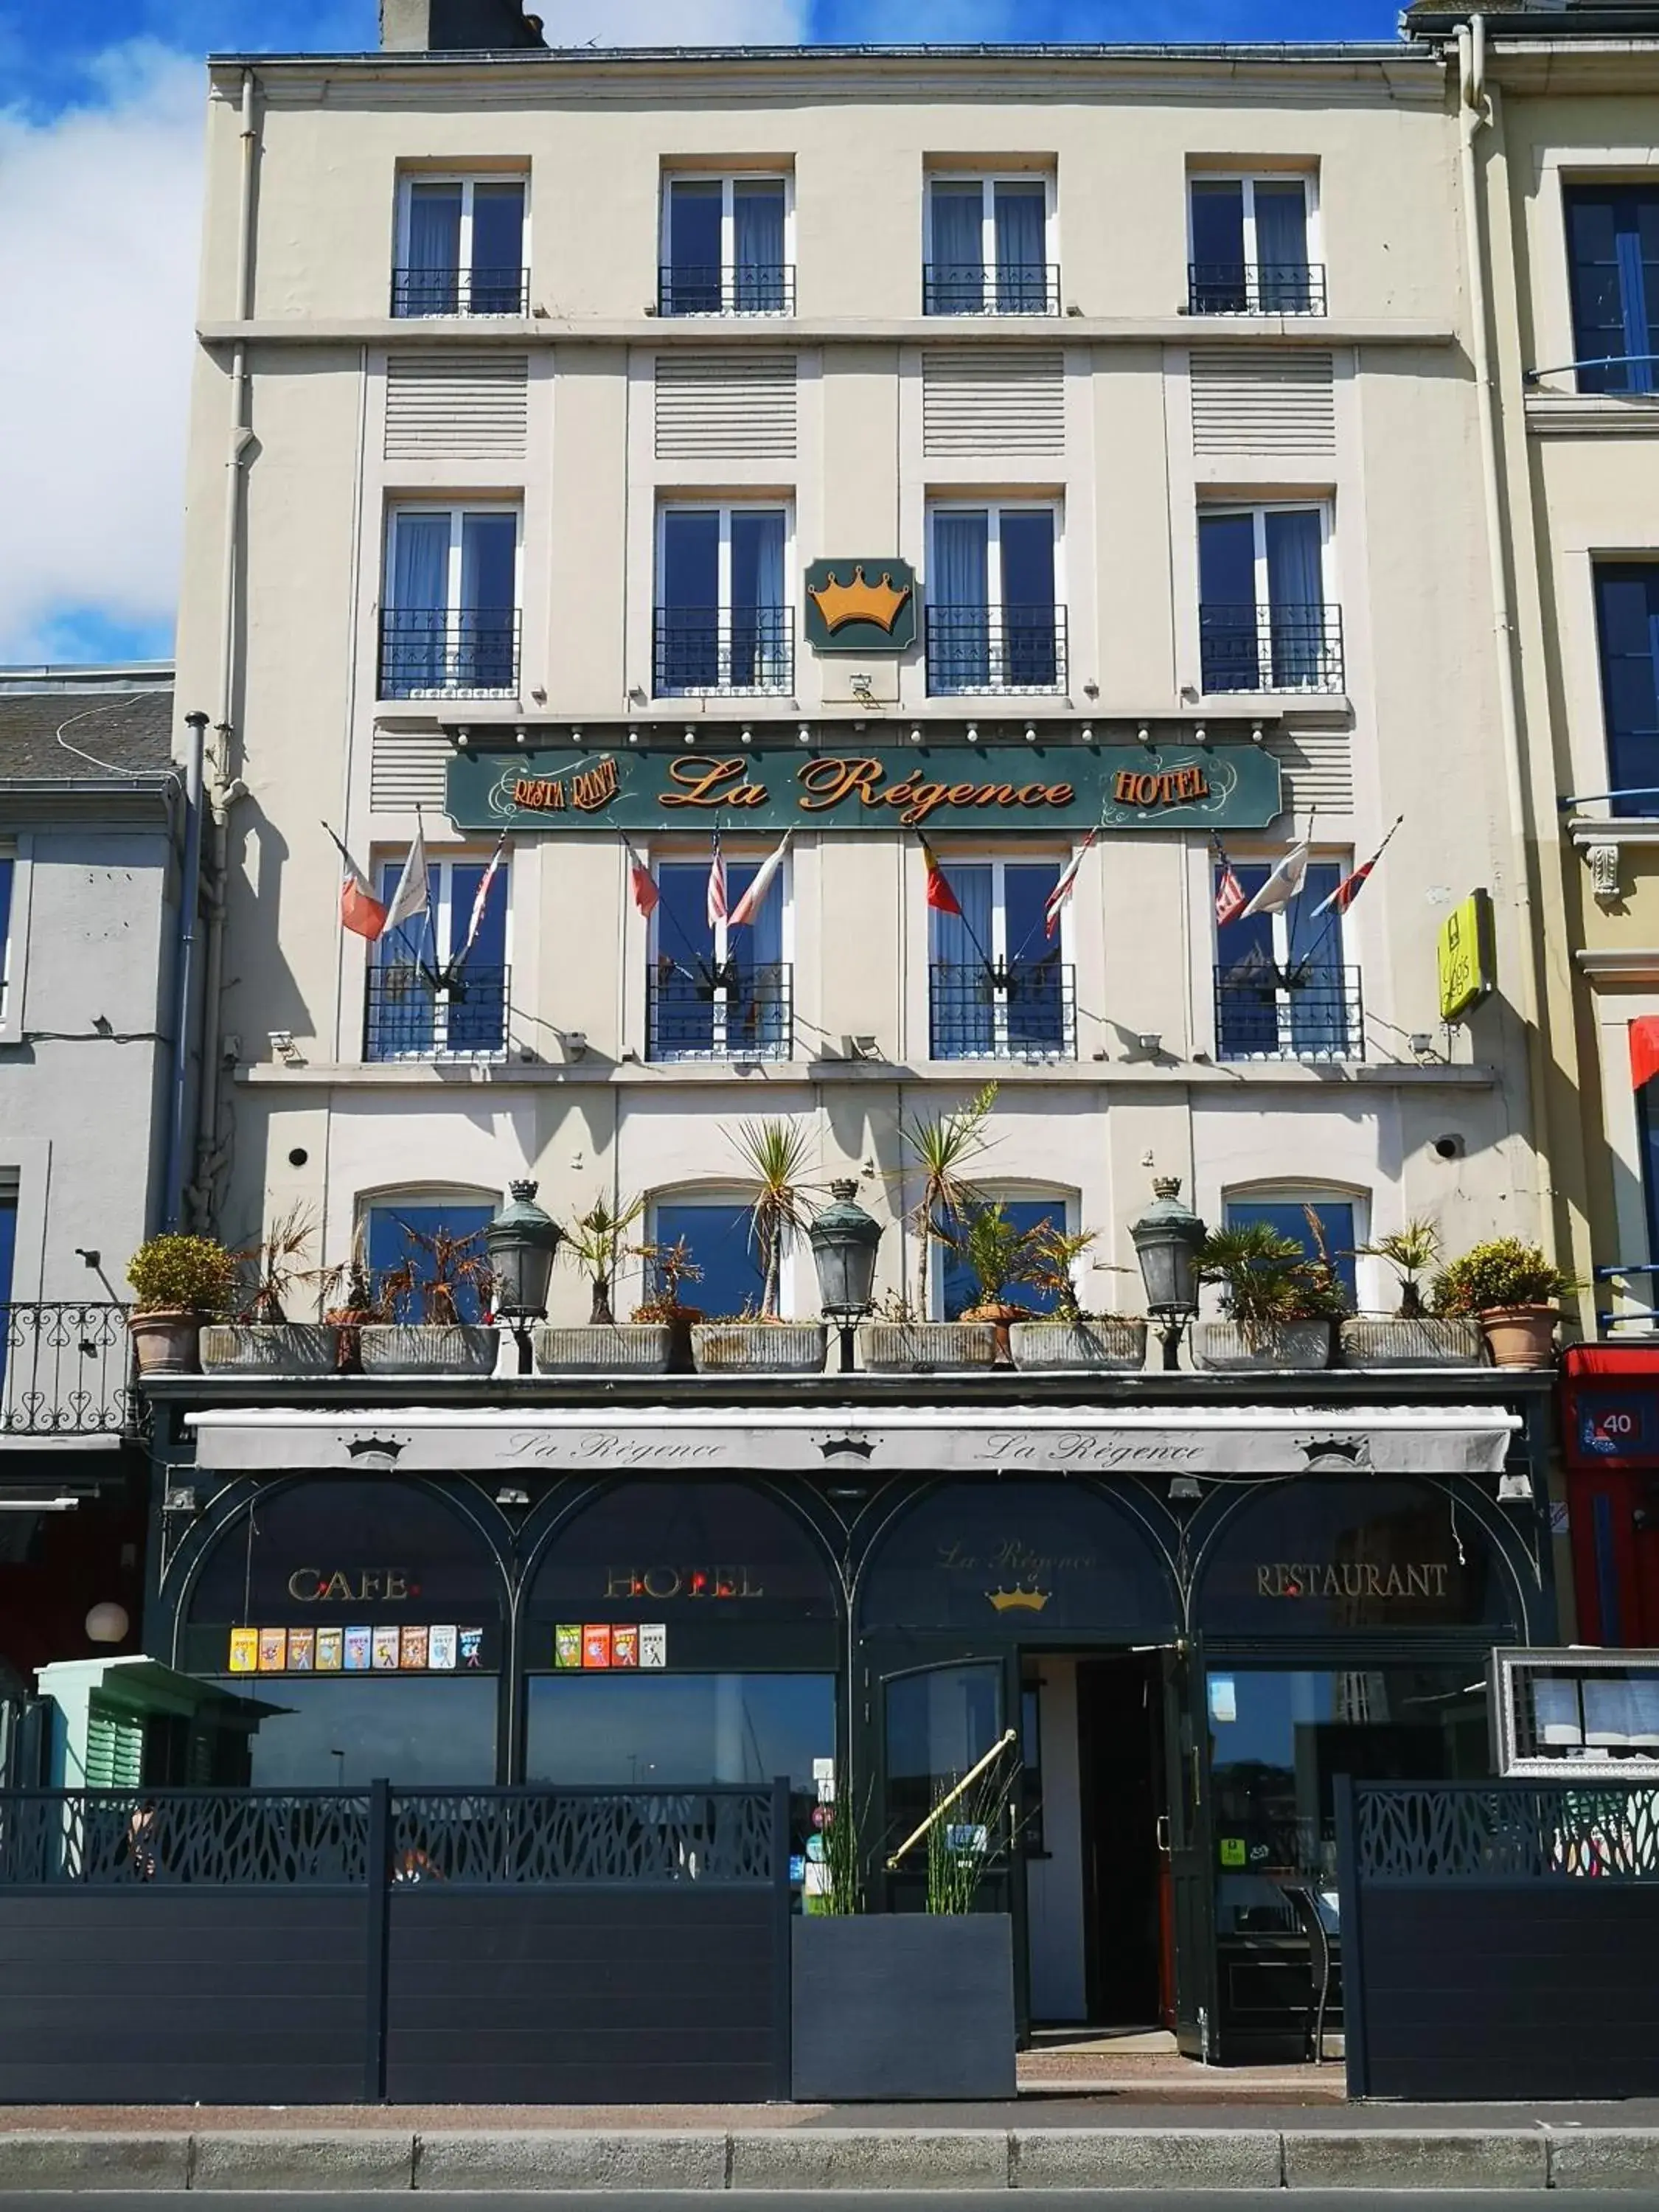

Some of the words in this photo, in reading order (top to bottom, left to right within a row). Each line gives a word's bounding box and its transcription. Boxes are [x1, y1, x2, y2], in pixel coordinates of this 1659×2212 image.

[514, 758, 620, 811] RESTARANT
[658, 755, 769, 808] La
[797, 757, 1077, 826] Régence
[1113, 766, 1210, 807] HOTEL
[1603, 1414, 1632, 1433] 40
[495, 1433, 559, 1457] La
[973, 1434, 1036, 1459] La
[1048, 1433, 1204, 1468] Régence
[288, 1568, 408, 1601] CAFE
[602, 1565, 764, 1599] HOTEL
[1256, 1562, 1448, 1597] RESTAURANT
